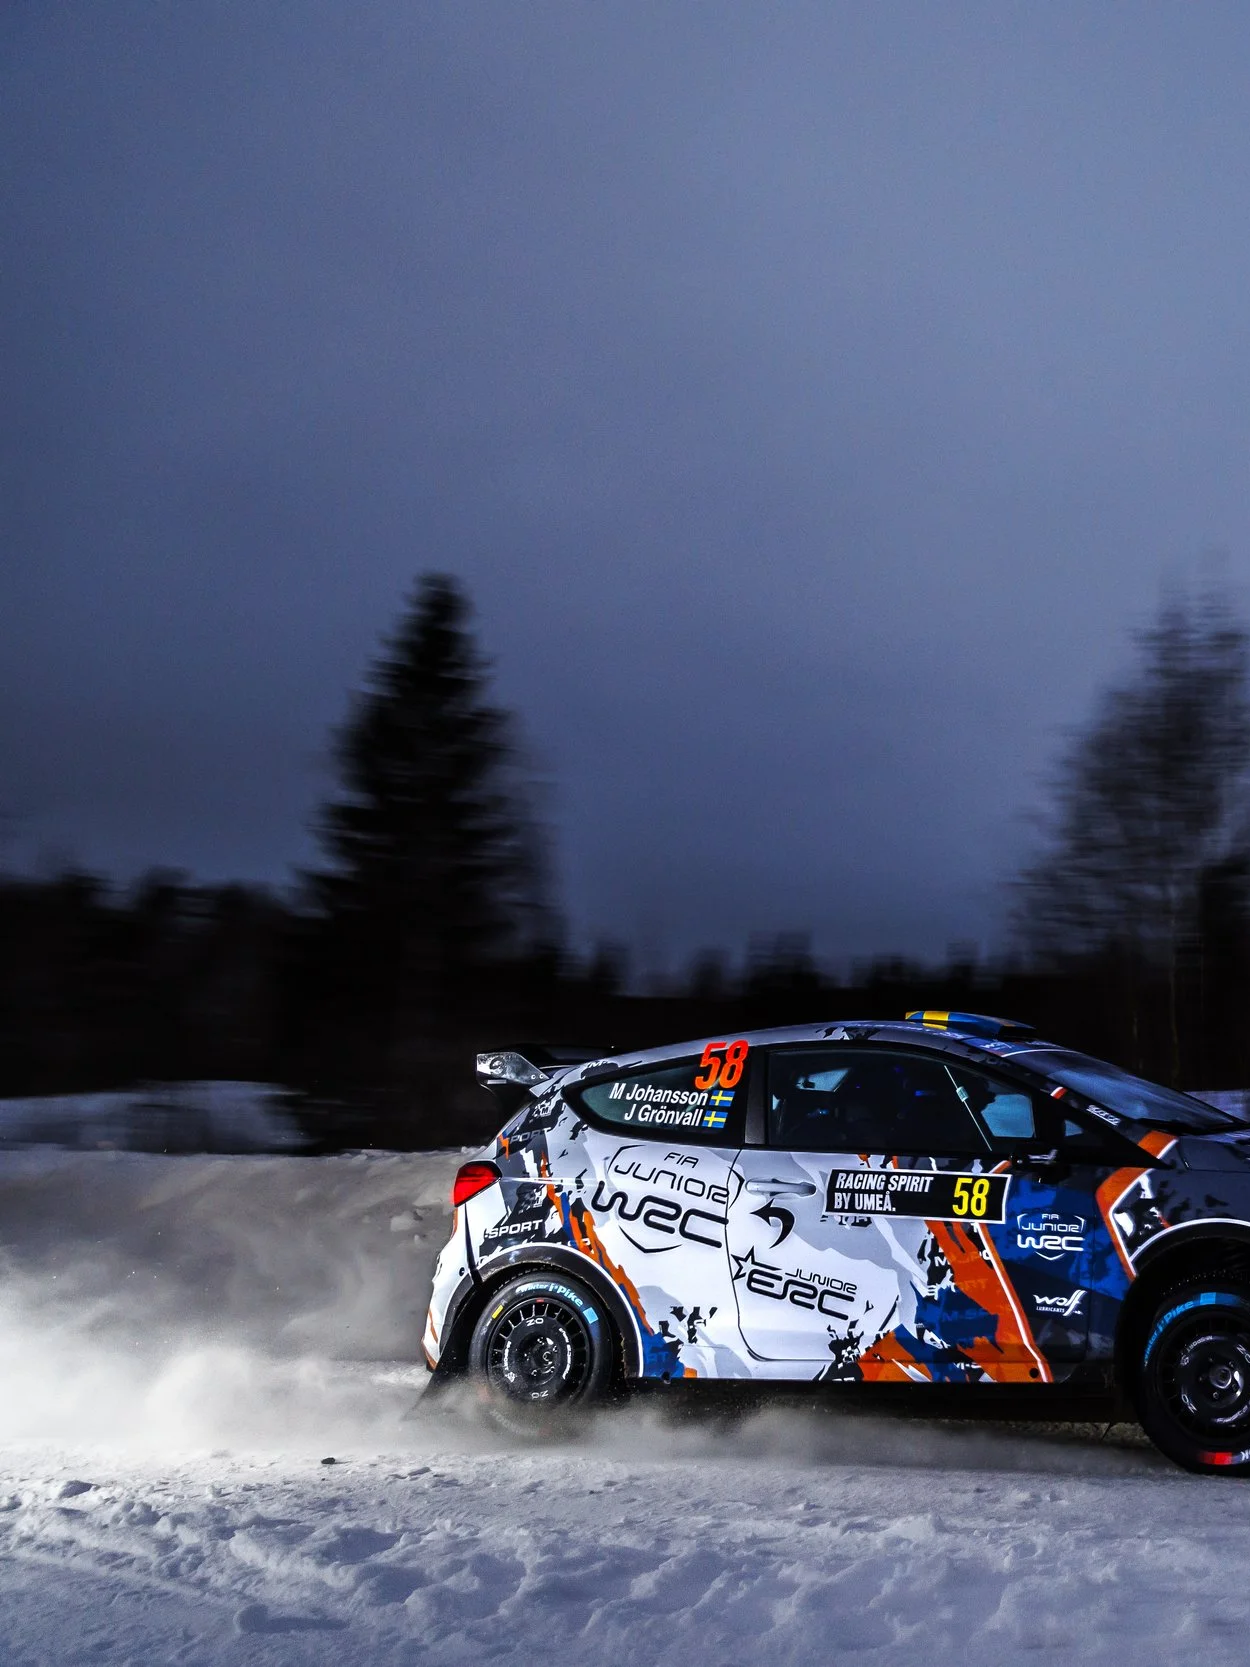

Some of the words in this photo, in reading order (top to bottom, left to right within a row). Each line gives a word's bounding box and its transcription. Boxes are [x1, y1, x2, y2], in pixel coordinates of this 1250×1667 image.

[695, 1040, 749, 1090] 58
[609, 1083, 627, 1100] M
[626, 1084, 708, 1106] Johansson
[624, 1104, 637, 1121] J
[638, 1105, 704, 1127] Grönvall
[664, 1152, 699, 1169] FIA
[614, 1161, 730, 1205] JUNIOR
[836, 1173, 885, 1191] RACING
[887, 1176, 934, 1193] SPIRIT
[834, 1192, 851, 1210] BY
[854, 1191, 896, 1212] UMEÅ.
[952, 1177, 990, 1217] 58
[591, 1180, 729, 1248] WRC
[1021, 1222, 1081, 1233] JUNIOR
[1016, 1233, 1085, 1252] WRC
[784, 1268, 857, 1295] JUNIOR
[746, 1268, 855, 1321] ERC
[1036, 1305, 1065, 1313] LUBRICANTS
